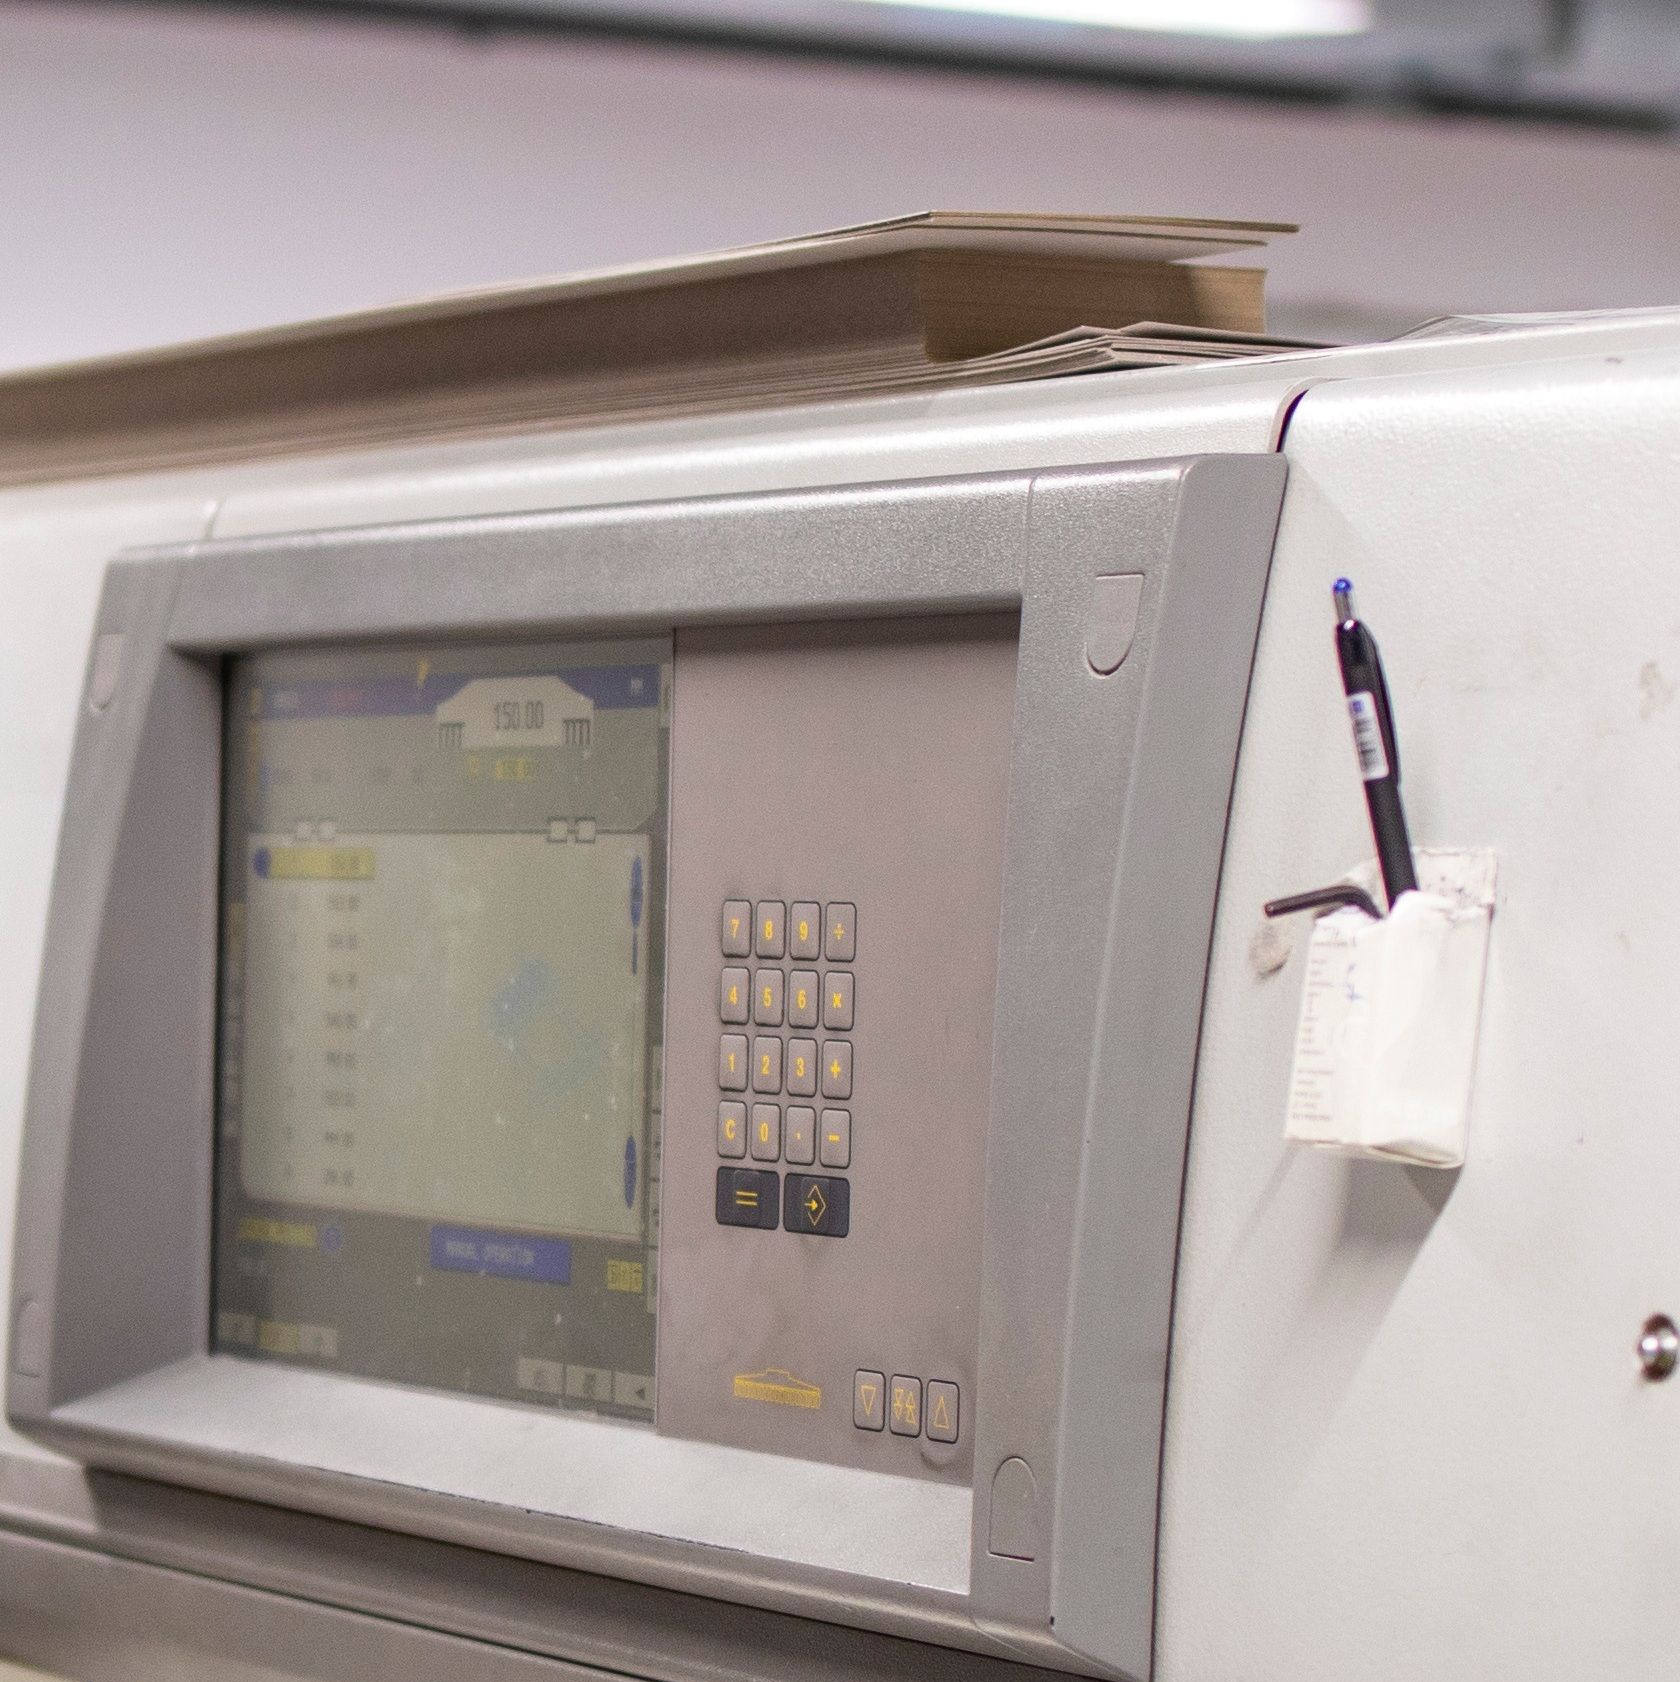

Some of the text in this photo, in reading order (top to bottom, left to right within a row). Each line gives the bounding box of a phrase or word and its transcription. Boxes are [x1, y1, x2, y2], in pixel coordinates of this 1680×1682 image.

[729, 917, 741, 938] 7
[763, 919, 774, 941] 8
[798, 920, 809, 941] 9
[728, 984, 739, 1006] 4
[762, 986, 772, 1008] 5
[796, 988, 807, 1010] 6
[727, 1053, 736, 1073] 1
[760, 1054, 771, 1076] 2
[795, 1056, 806, 1078] 3
[724, 1118, 737, 1142] C
[758, 1121, 770, 1143] 0
